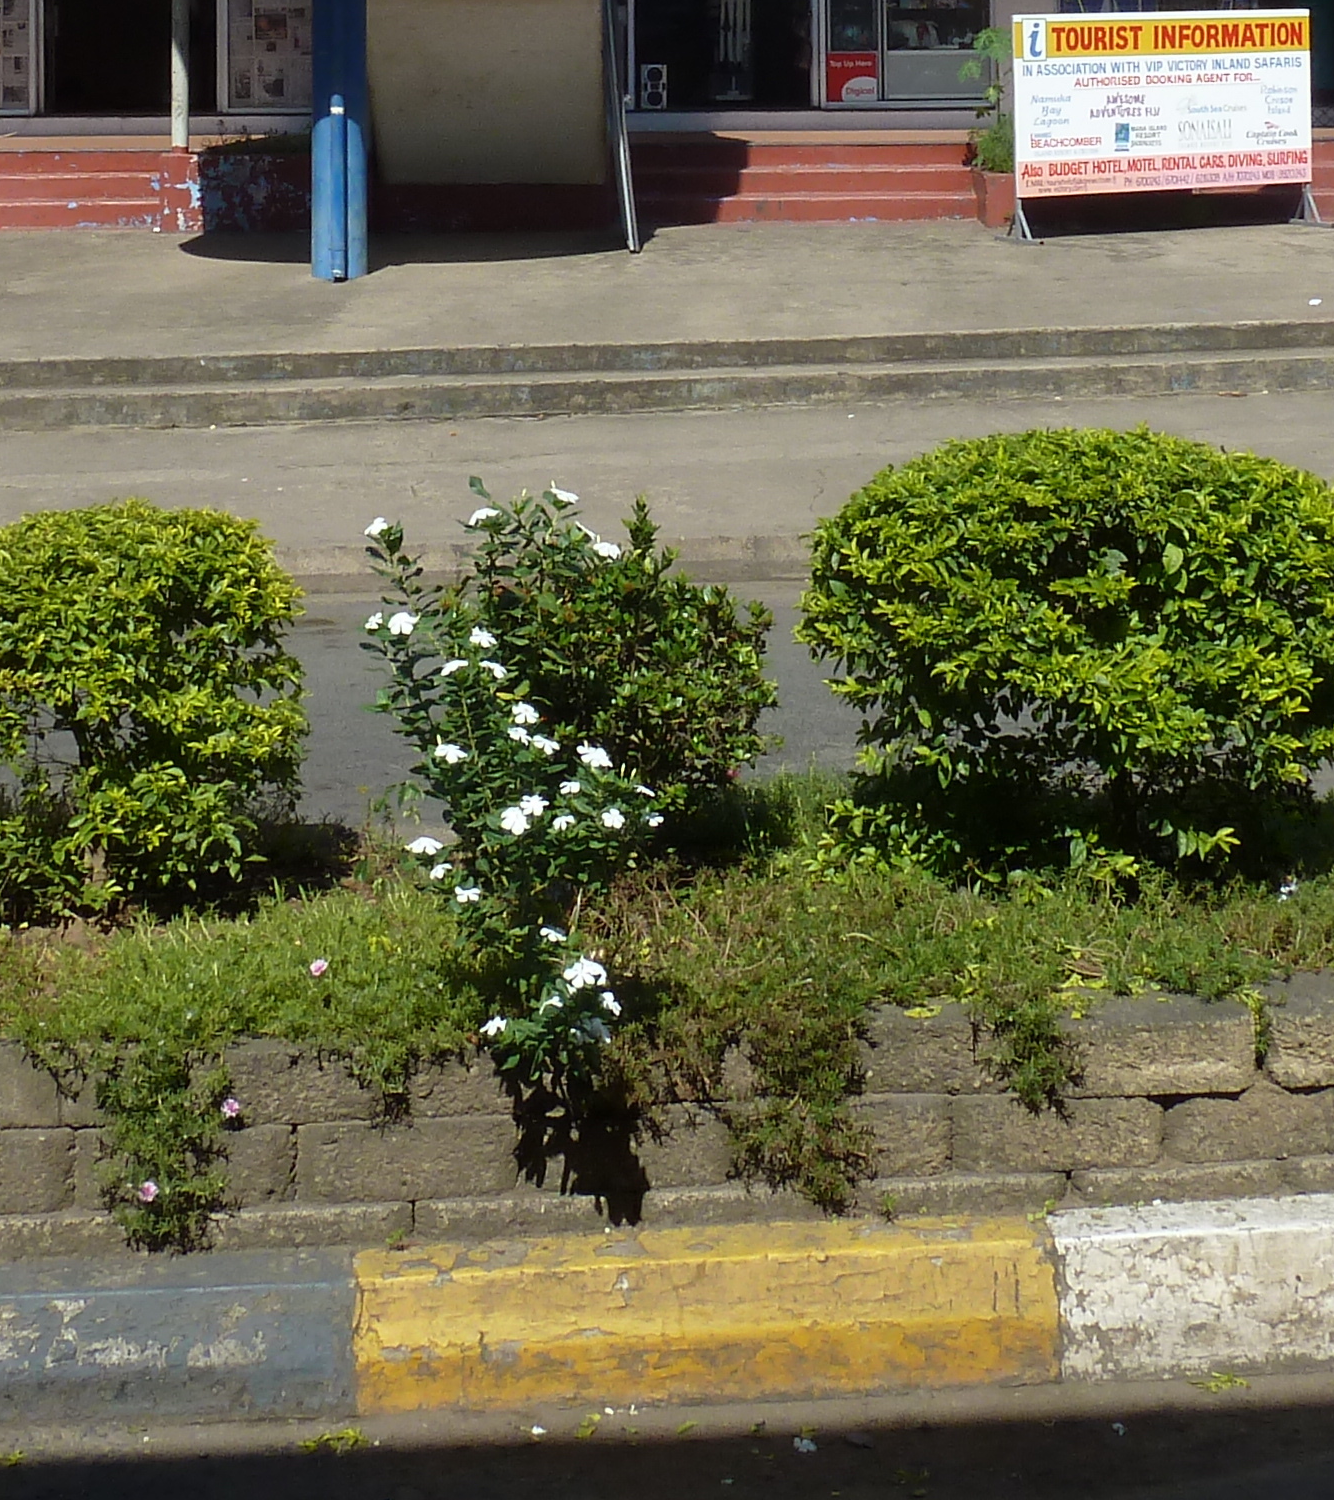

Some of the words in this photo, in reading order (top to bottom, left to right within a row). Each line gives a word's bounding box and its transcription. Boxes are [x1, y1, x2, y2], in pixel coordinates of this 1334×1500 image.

[1051, 24, 1144, 53] TOURIST
[1152, 21, 1304, 50] INFORMATION
[1022, 63, 1034, 77] IN
[1037, 62, 1107, 77] ASSOCIATION
[1110, 61, 1141, 75] WITH
[1144, 60, 1164, 73] VIP
[1167, 59, 1208, 73] VICTORY
[1211, 57, 1251, 71] INLAND
[1254, 56, 1303, 69] SAFARIS
[1073, 76, 1141, 88] AUTHORISED
[1145, 74, 1193, 86] BOOKING
[1195, 73, 1231, 84] AGENT
[845, 86, 875, 98] Digicel
[1030, 136, 1102, 149] BEACHCOMBER
[1021, 162, 1044, 181] Also
[1048, 161, 1090, 178] BUDGET
[1161, 155, 1197, 172] RENTAL
[1266, 150, 1308, 166] SURFING
